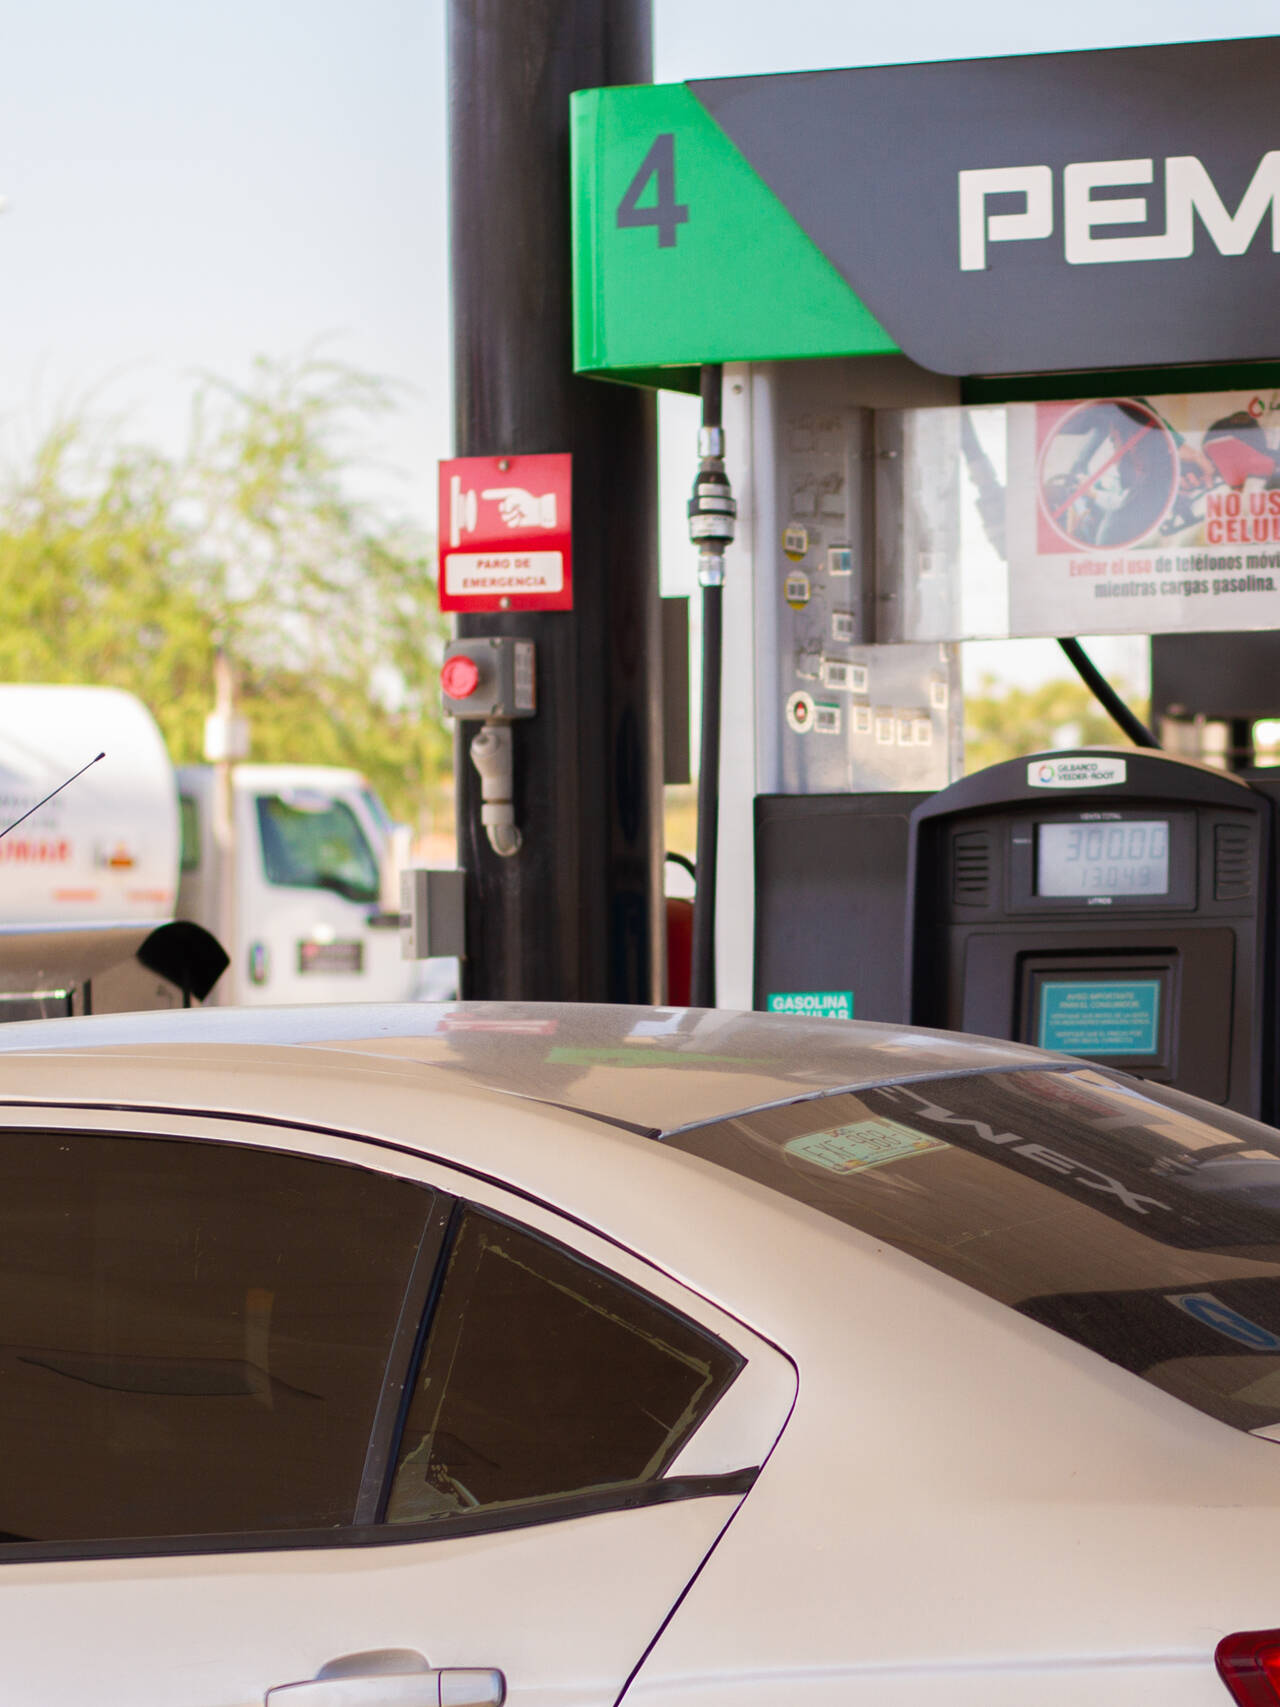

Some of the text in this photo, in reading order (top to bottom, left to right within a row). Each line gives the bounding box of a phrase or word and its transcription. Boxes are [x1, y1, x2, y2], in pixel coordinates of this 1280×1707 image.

[616, 133, 689, 248] 4
[1206, 494, 1241, 518] NO
[477, 558, 530, 569] PARO DE
[1069, 559, 1107, 577] Evitar
[1111, 558, 1125, 576] el
[1127, 559, 1152, 575] uso
[1155, 556, 1173, 573] de
[462, 577, 546, 588] EMERGENCIA
[1094, 575, 1277, 598] mientras cargas gasolina.
[772, 995, 848, 1010] GASOLINA
